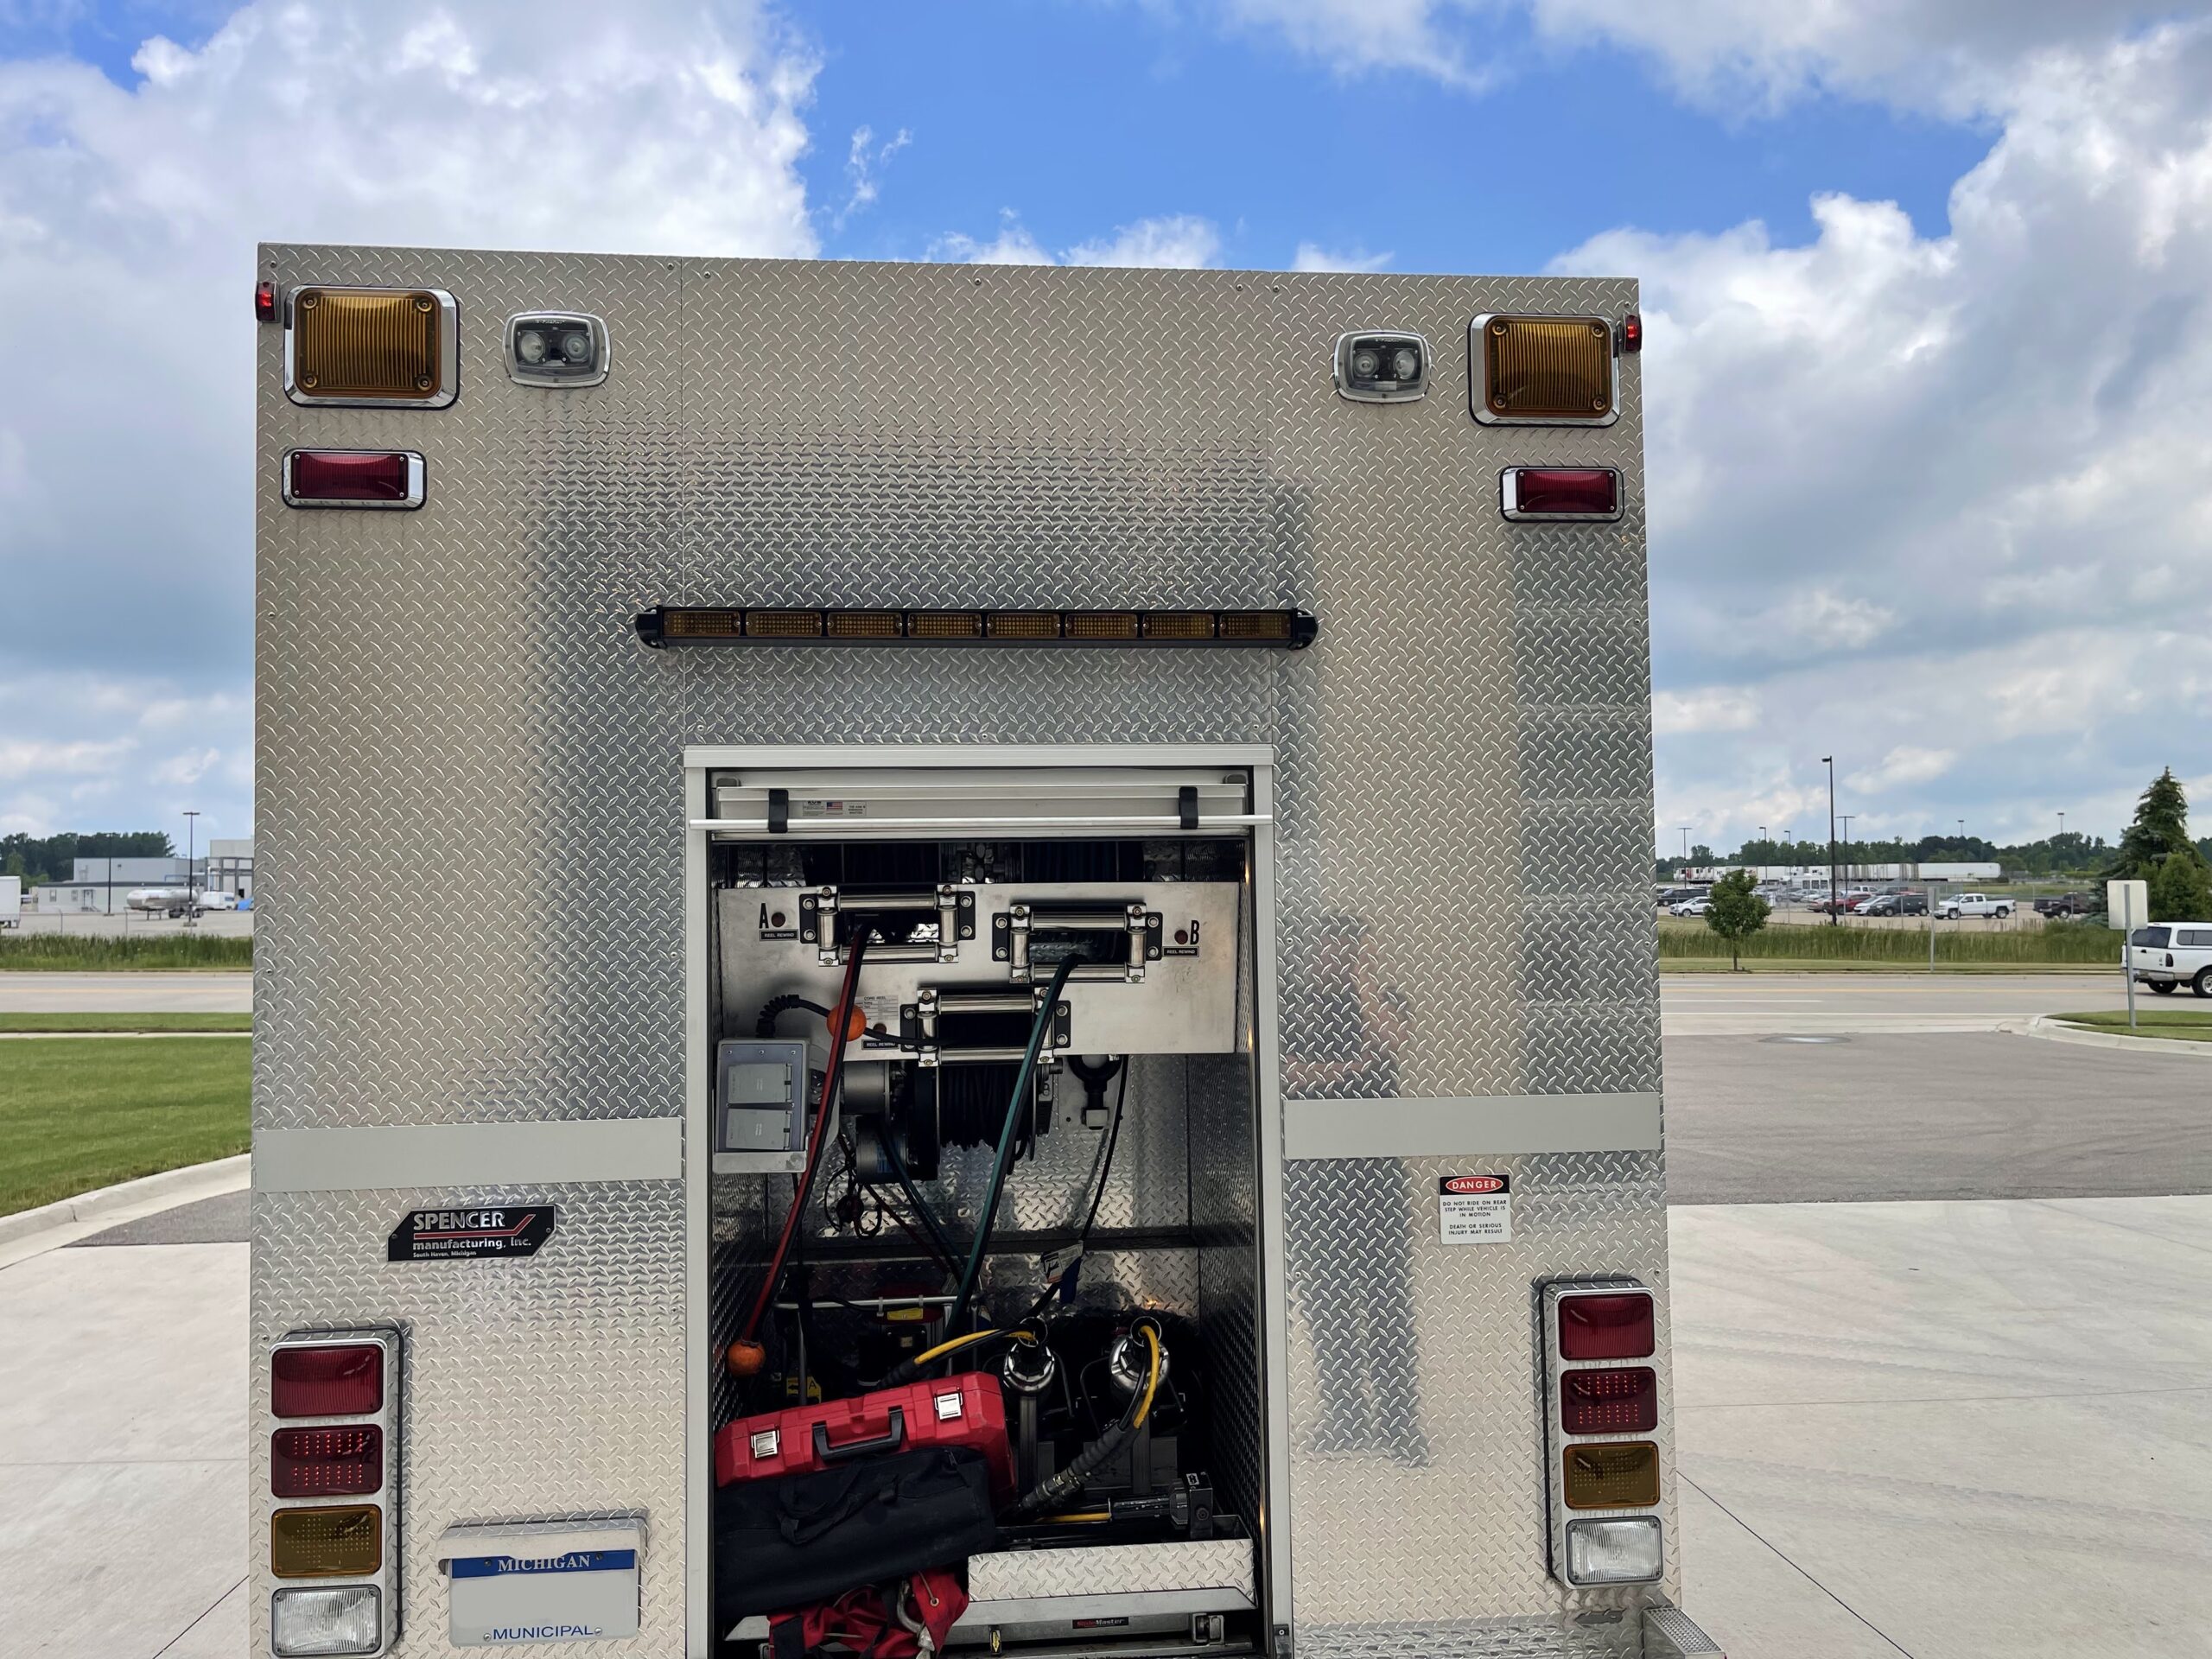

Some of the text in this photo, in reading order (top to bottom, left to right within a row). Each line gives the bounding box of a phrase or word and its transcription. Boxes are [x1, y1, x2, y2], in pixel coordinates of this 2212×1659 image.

[759, 902, 769, 929] A
[1190, 919, 1200, 945] B
[413, 1211, 505, 1230] SPENCER
[808, 1381, 817, 1390] A
[498, 1555, 590, 1573] MICHIGAN
[493, 1625, 594, 1640] MUNICIPAL
